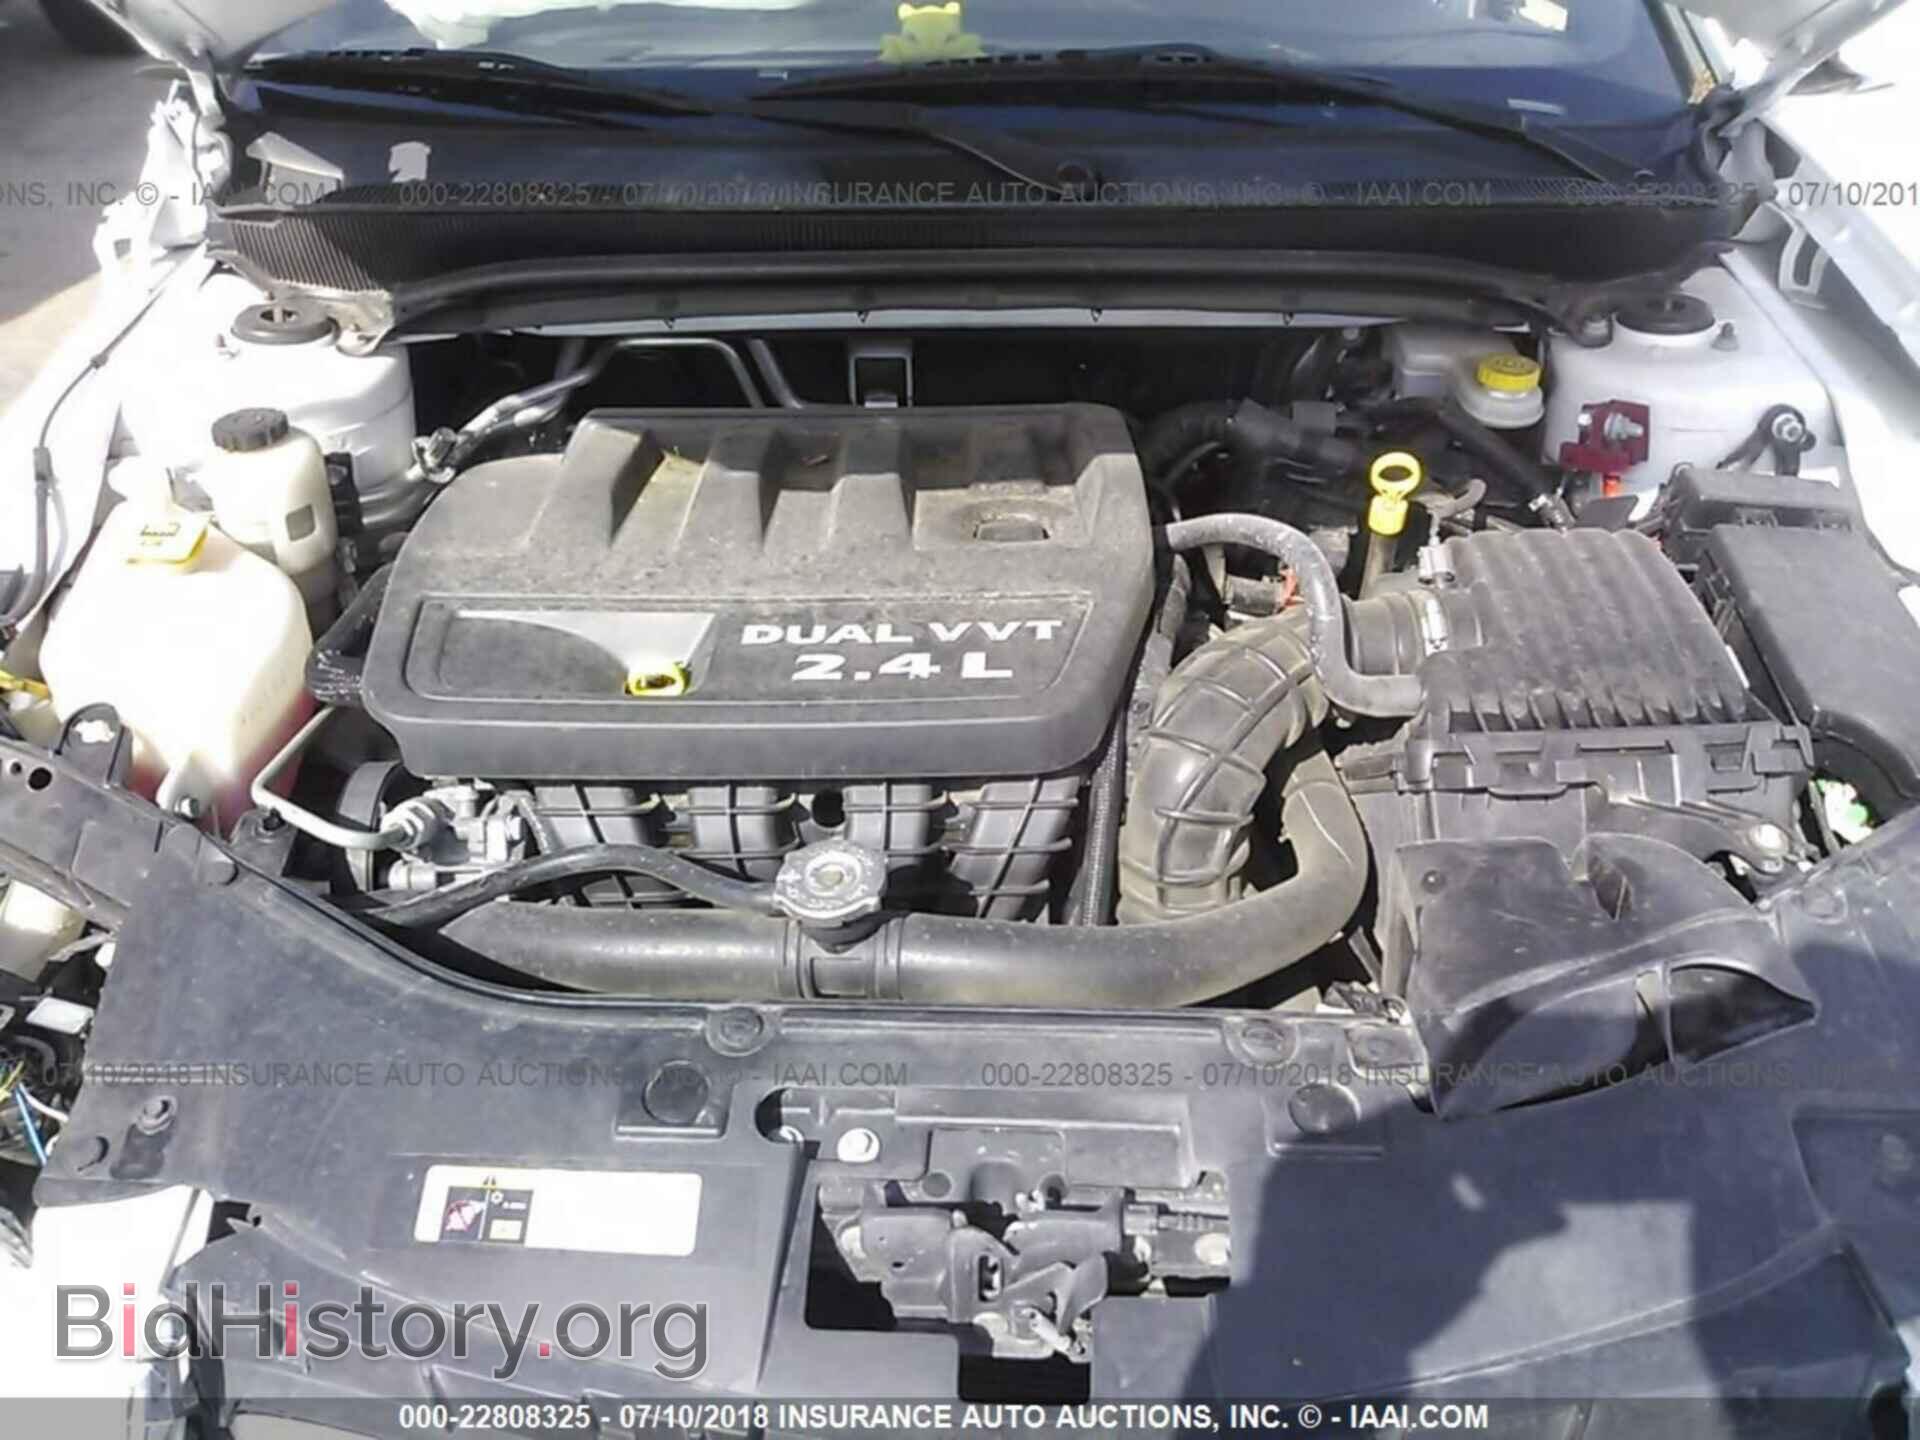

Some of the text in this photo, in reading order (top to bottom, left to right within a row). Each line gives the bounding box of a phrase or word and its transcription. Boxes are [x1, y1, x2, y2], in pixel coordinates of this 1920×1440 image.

[741, 619, 1063, 645] DUAL VVT
[791, 651, 1014, 681] 2.4 L
